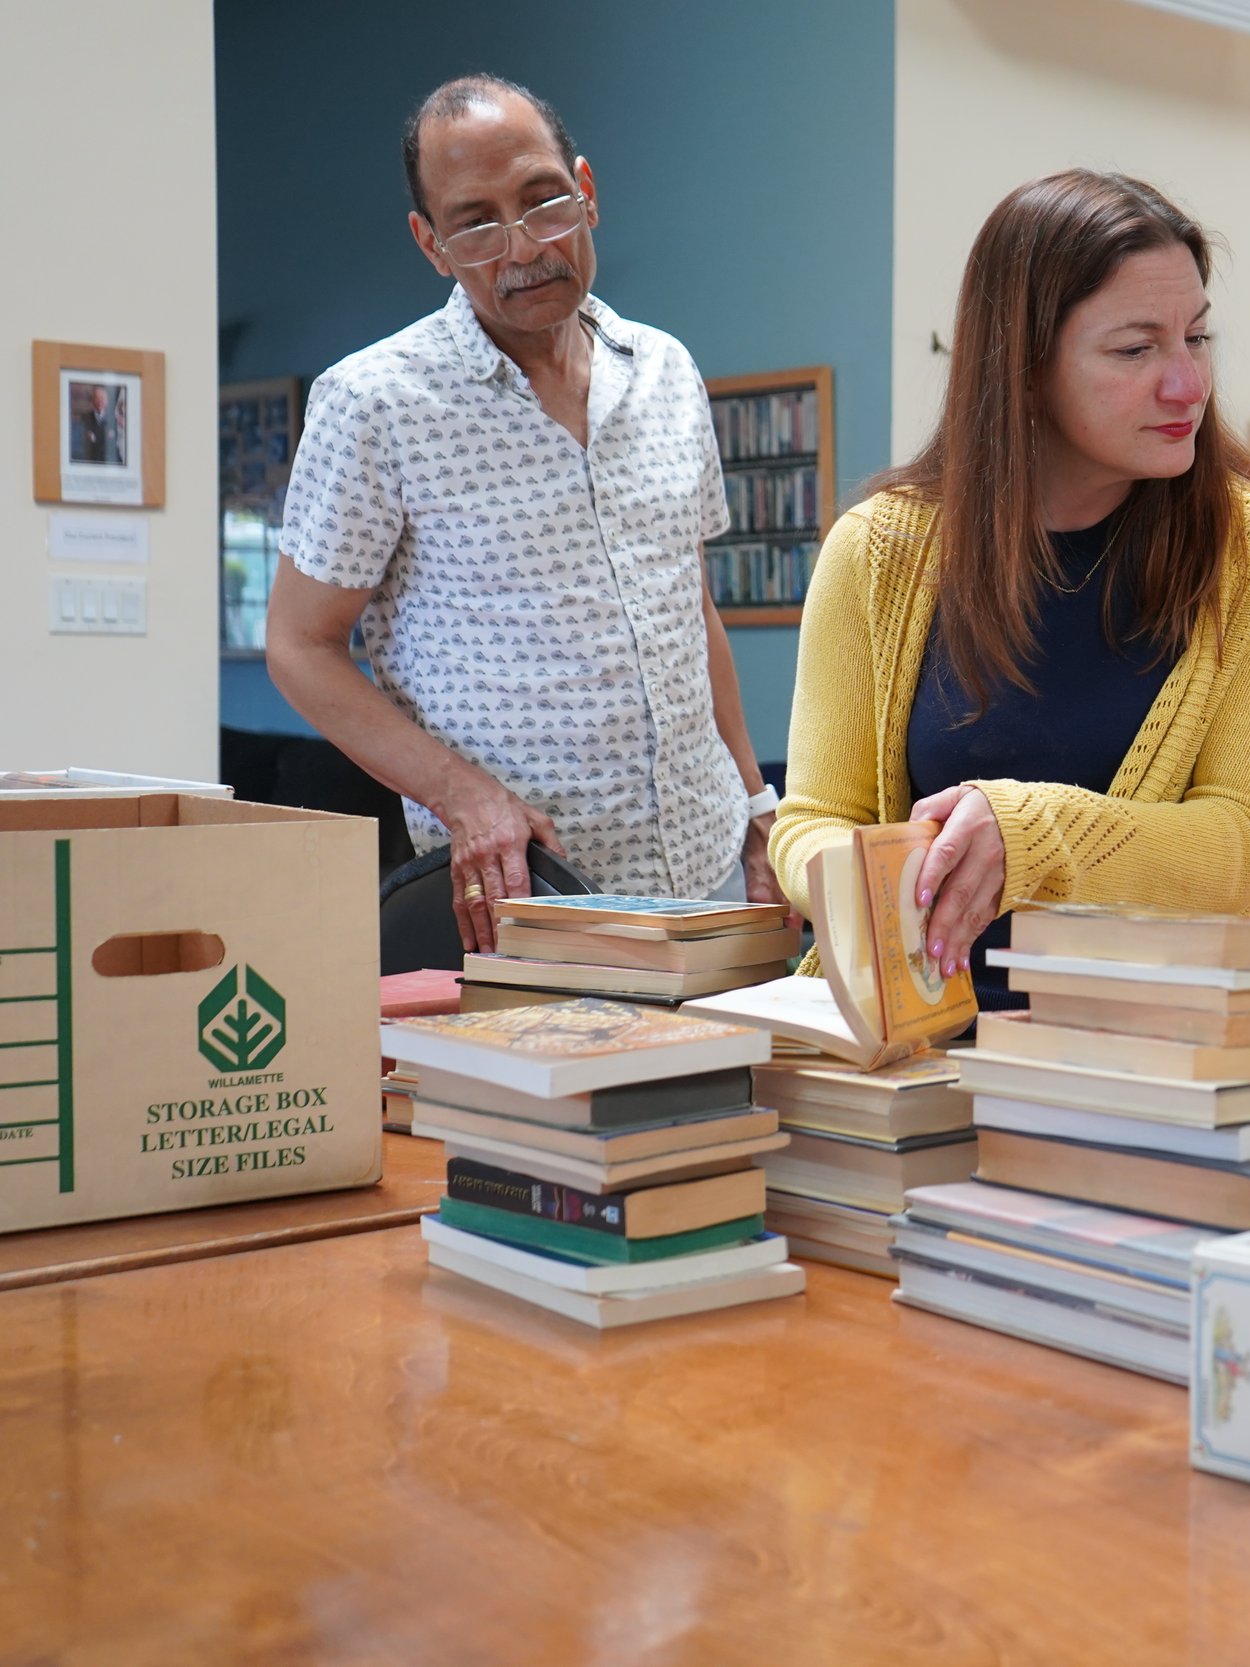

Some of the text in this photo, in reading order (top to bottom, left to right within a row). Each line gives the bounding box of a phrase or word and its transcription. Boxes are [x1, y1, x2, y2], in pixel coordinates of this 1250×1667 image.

[208, 1072, 284, 1089] WILLAMETTE
[146, 1087, 328, 1124] STORAGE BOX
[0, 1127, 33, 1140] DATE
[140, 1114, 334, 1153] LETTER/LEGAL
[171, 1146, 306, 1179] SIZE FILES
